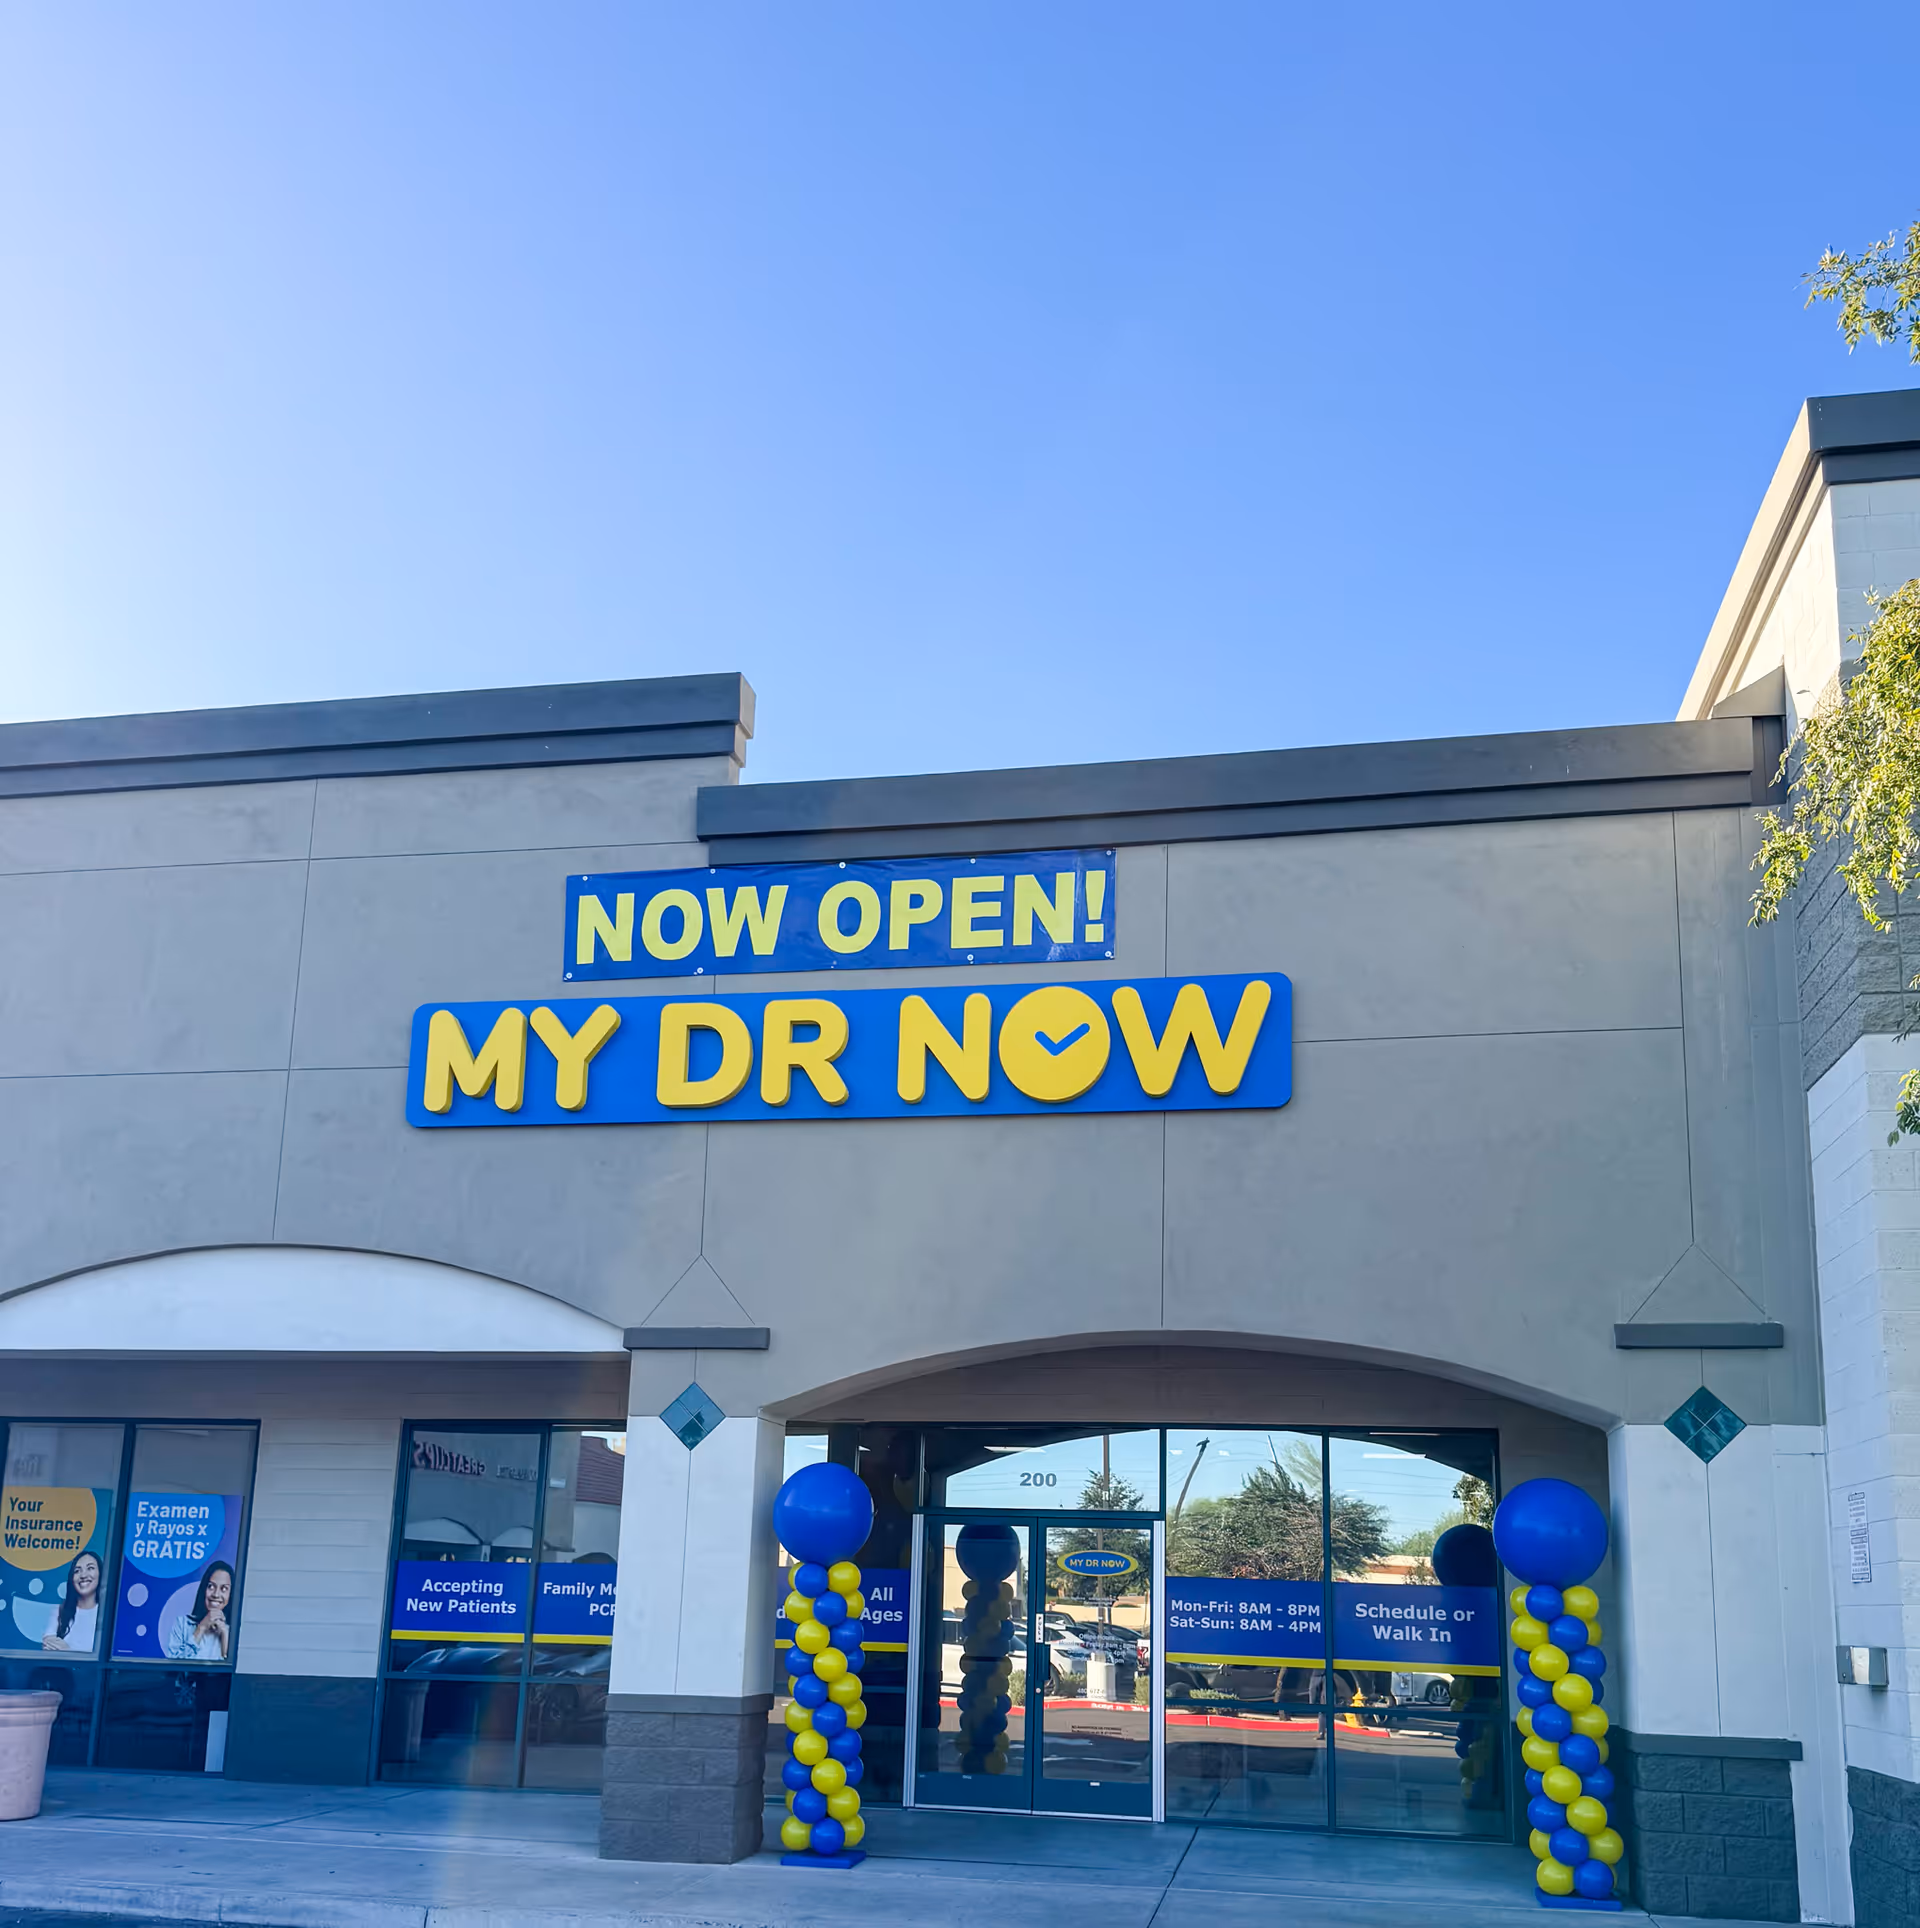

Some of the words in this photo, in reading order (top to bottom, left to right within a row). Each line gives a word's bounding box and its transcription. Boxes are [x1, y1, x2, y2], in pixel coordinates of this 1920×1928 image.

[576, 884, 789, 965] NOW
[817, 870, 1107, 954] OPEN!
[424, 1004, 621, 1113] MY
[657, 998, 850, 1108] DR
[897, 979, 1272, 1104] NOW
[1019, 1472, 1057, 1487] 200
[9, 1497, 44, 1512] Your
[137, 1501, 210, 1519] Examen
[5, 1515, 83, 1532] Insurance
[135, 1523, 144, 1537] y
[147, 1520, 194, 1538] Rayos
[198, 1523, 207, 1536] x
[4, 1533, 80, 1550] Welcome!
[1069, 1559, 1083, 1567] MY
[1085, 1559, 1099, 1567] DR
[1101, 1560, 1125, 1568] NOW
[421, 1579, 504, 1597] Accepting
[543, 1582, 595, 1598] Family
[870, 1587, 893, 1601] All
[406, 1598, 442, 1612] New
[448, 1599, 517, 1614] Patients
[1171, 1600, 1234, 1613] Mon-Fri:
[1238, 1602, 1272, 1614] 8AM
[1287, 1604, 1320, 1617] 8PM
[1355, 1603, 1447, 1621] Schedule
[1453, 1610, 1475, 1621] or
[860, 1607, 903, 1624] Ages
[1169, 1616, 1235, 1630] Sat-Sun:
[1239, 1618, 1272, 1631] 8AM
[1288, 1620, 1321, 1633] 4PM
[1372, 1625, 1423, 1641] Walk
[1429, 1627, 1452, 1642] In
